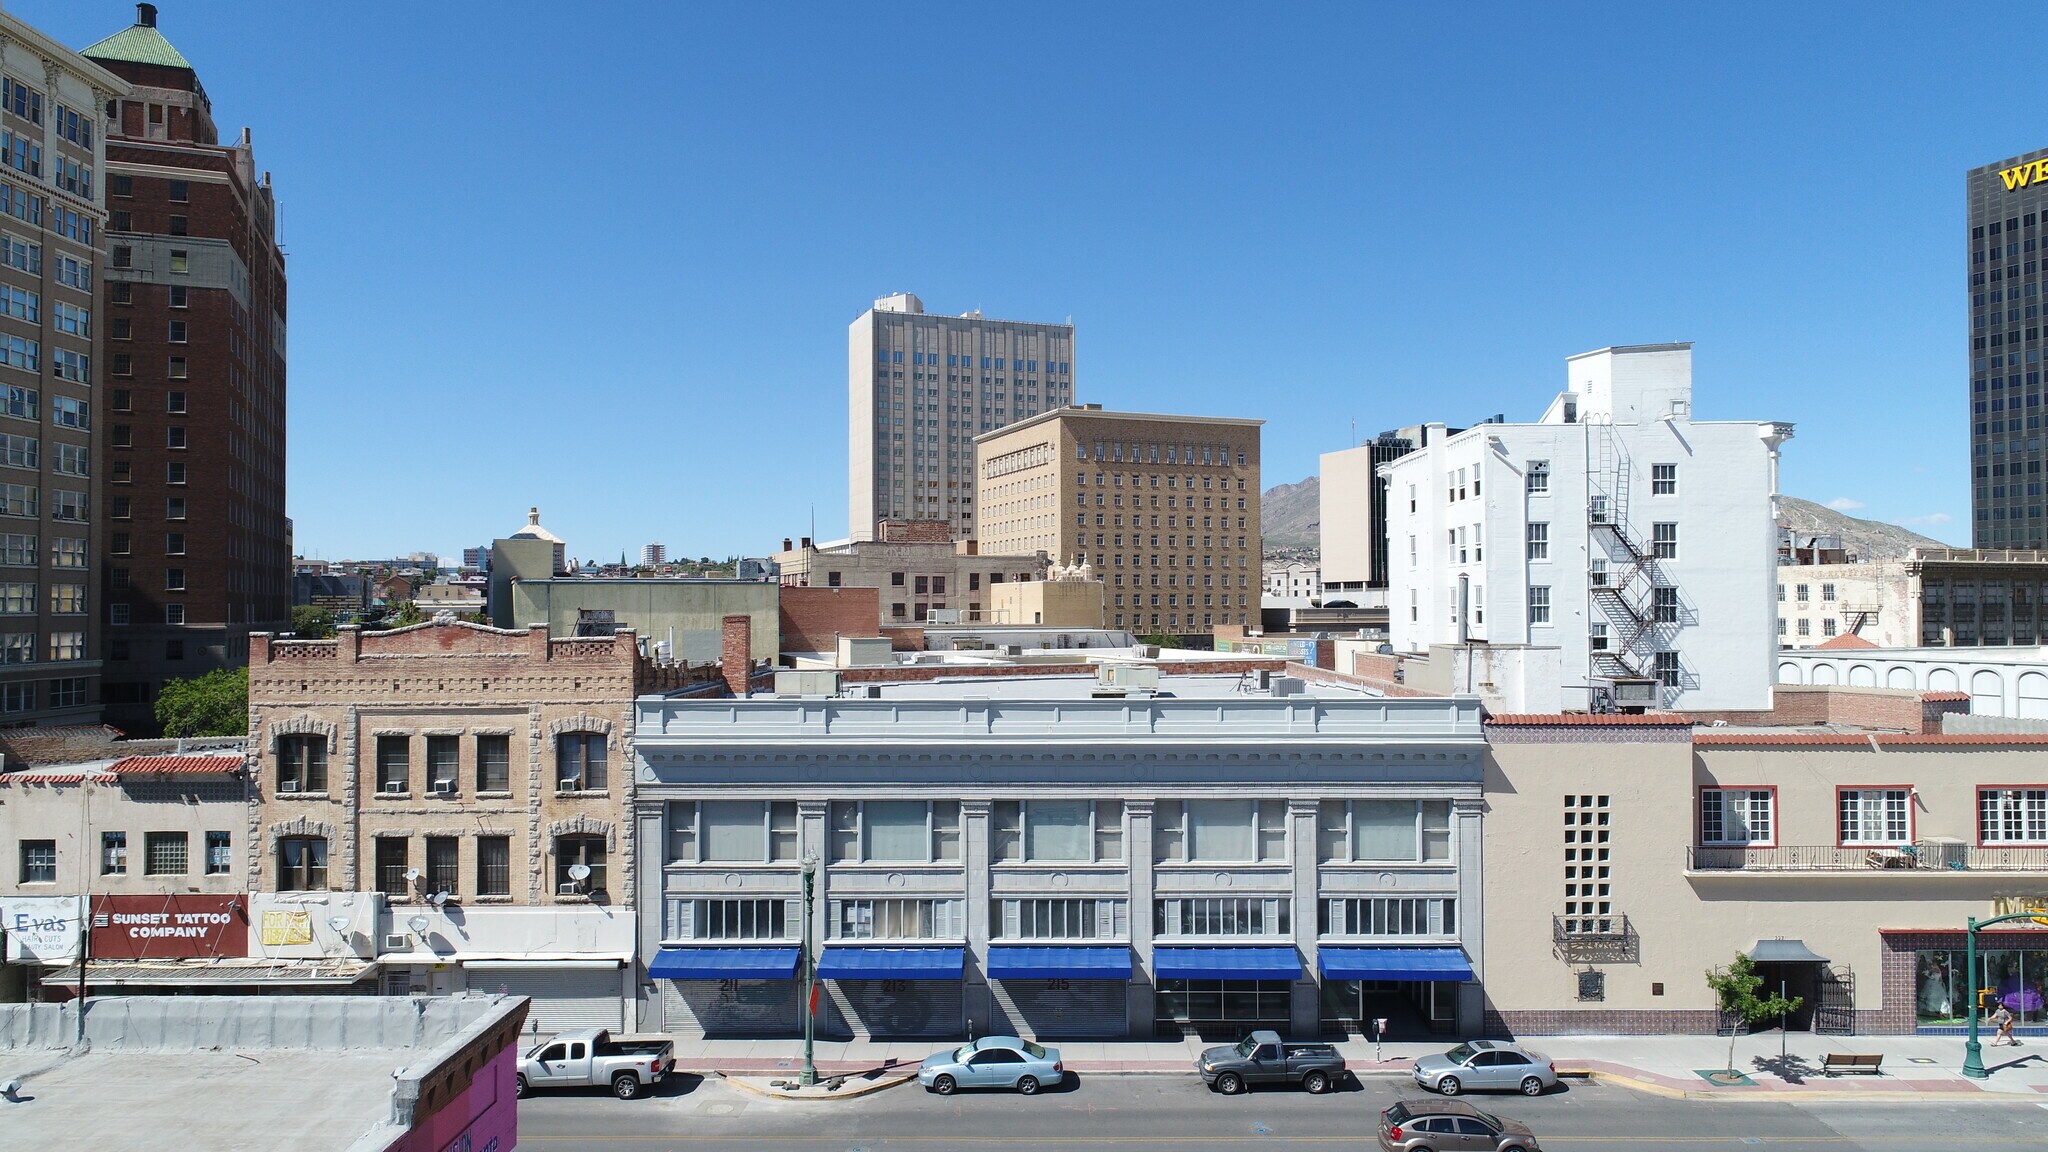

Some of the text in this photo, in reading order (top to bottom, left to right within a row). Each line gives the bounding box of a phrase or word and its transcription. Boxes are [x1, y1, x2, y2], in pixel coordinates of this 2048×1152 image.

[14, 913, 67, 932] Eva's
[112, 913, 231, 924] SUNSET TATTOO
[263, 911, 283, 927] FOR
[129, 926, 208, 938] COMPANY
